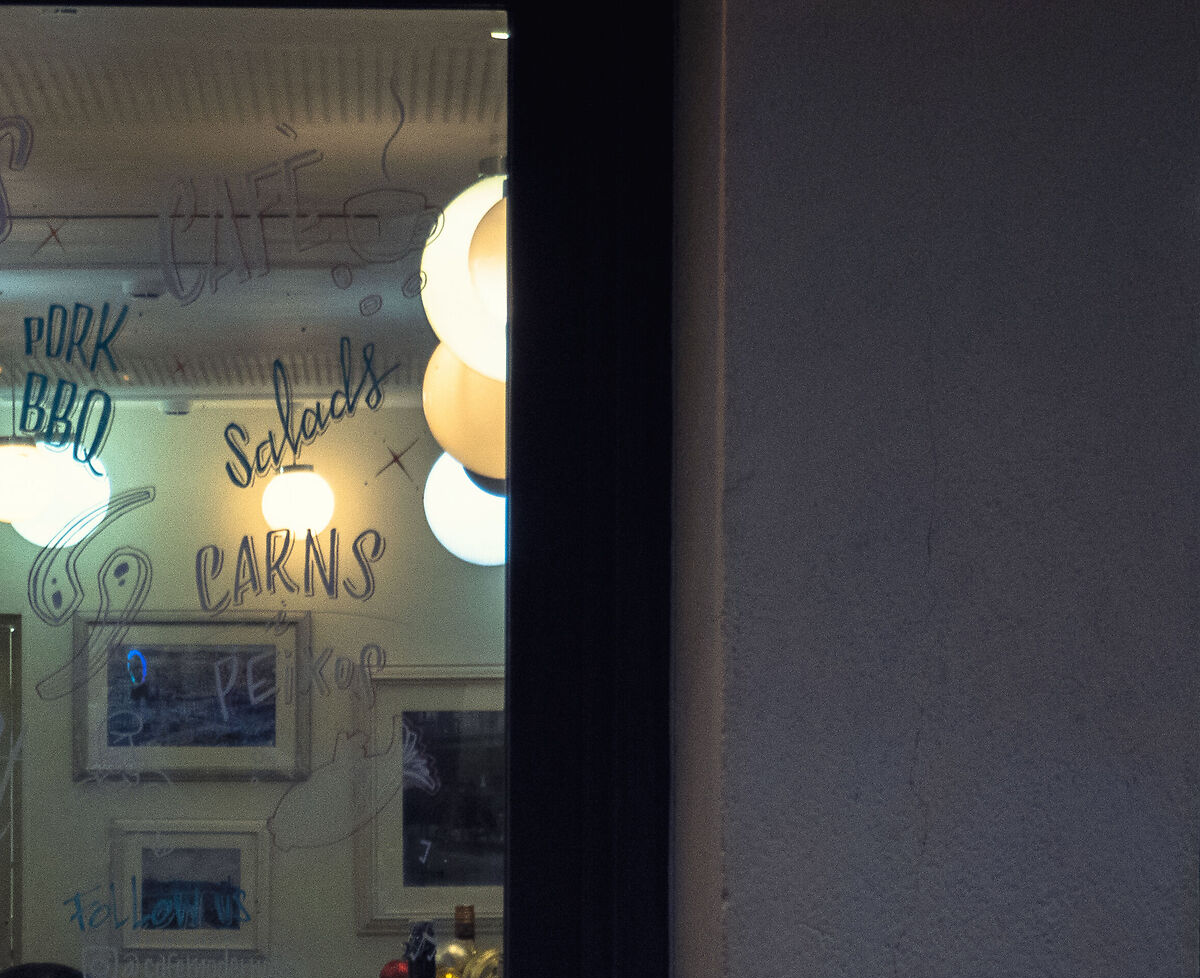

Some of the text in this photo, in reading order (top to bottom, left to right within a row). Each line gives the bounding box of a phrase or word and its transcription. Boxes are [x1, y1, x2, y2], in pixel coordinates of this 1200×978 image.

[23, 302, 129, 374] PORK
[19, 371, 115, 477] BBQ
[225, 336, 398, 489] Salads
[195, 528, 386, 617] CARNS
